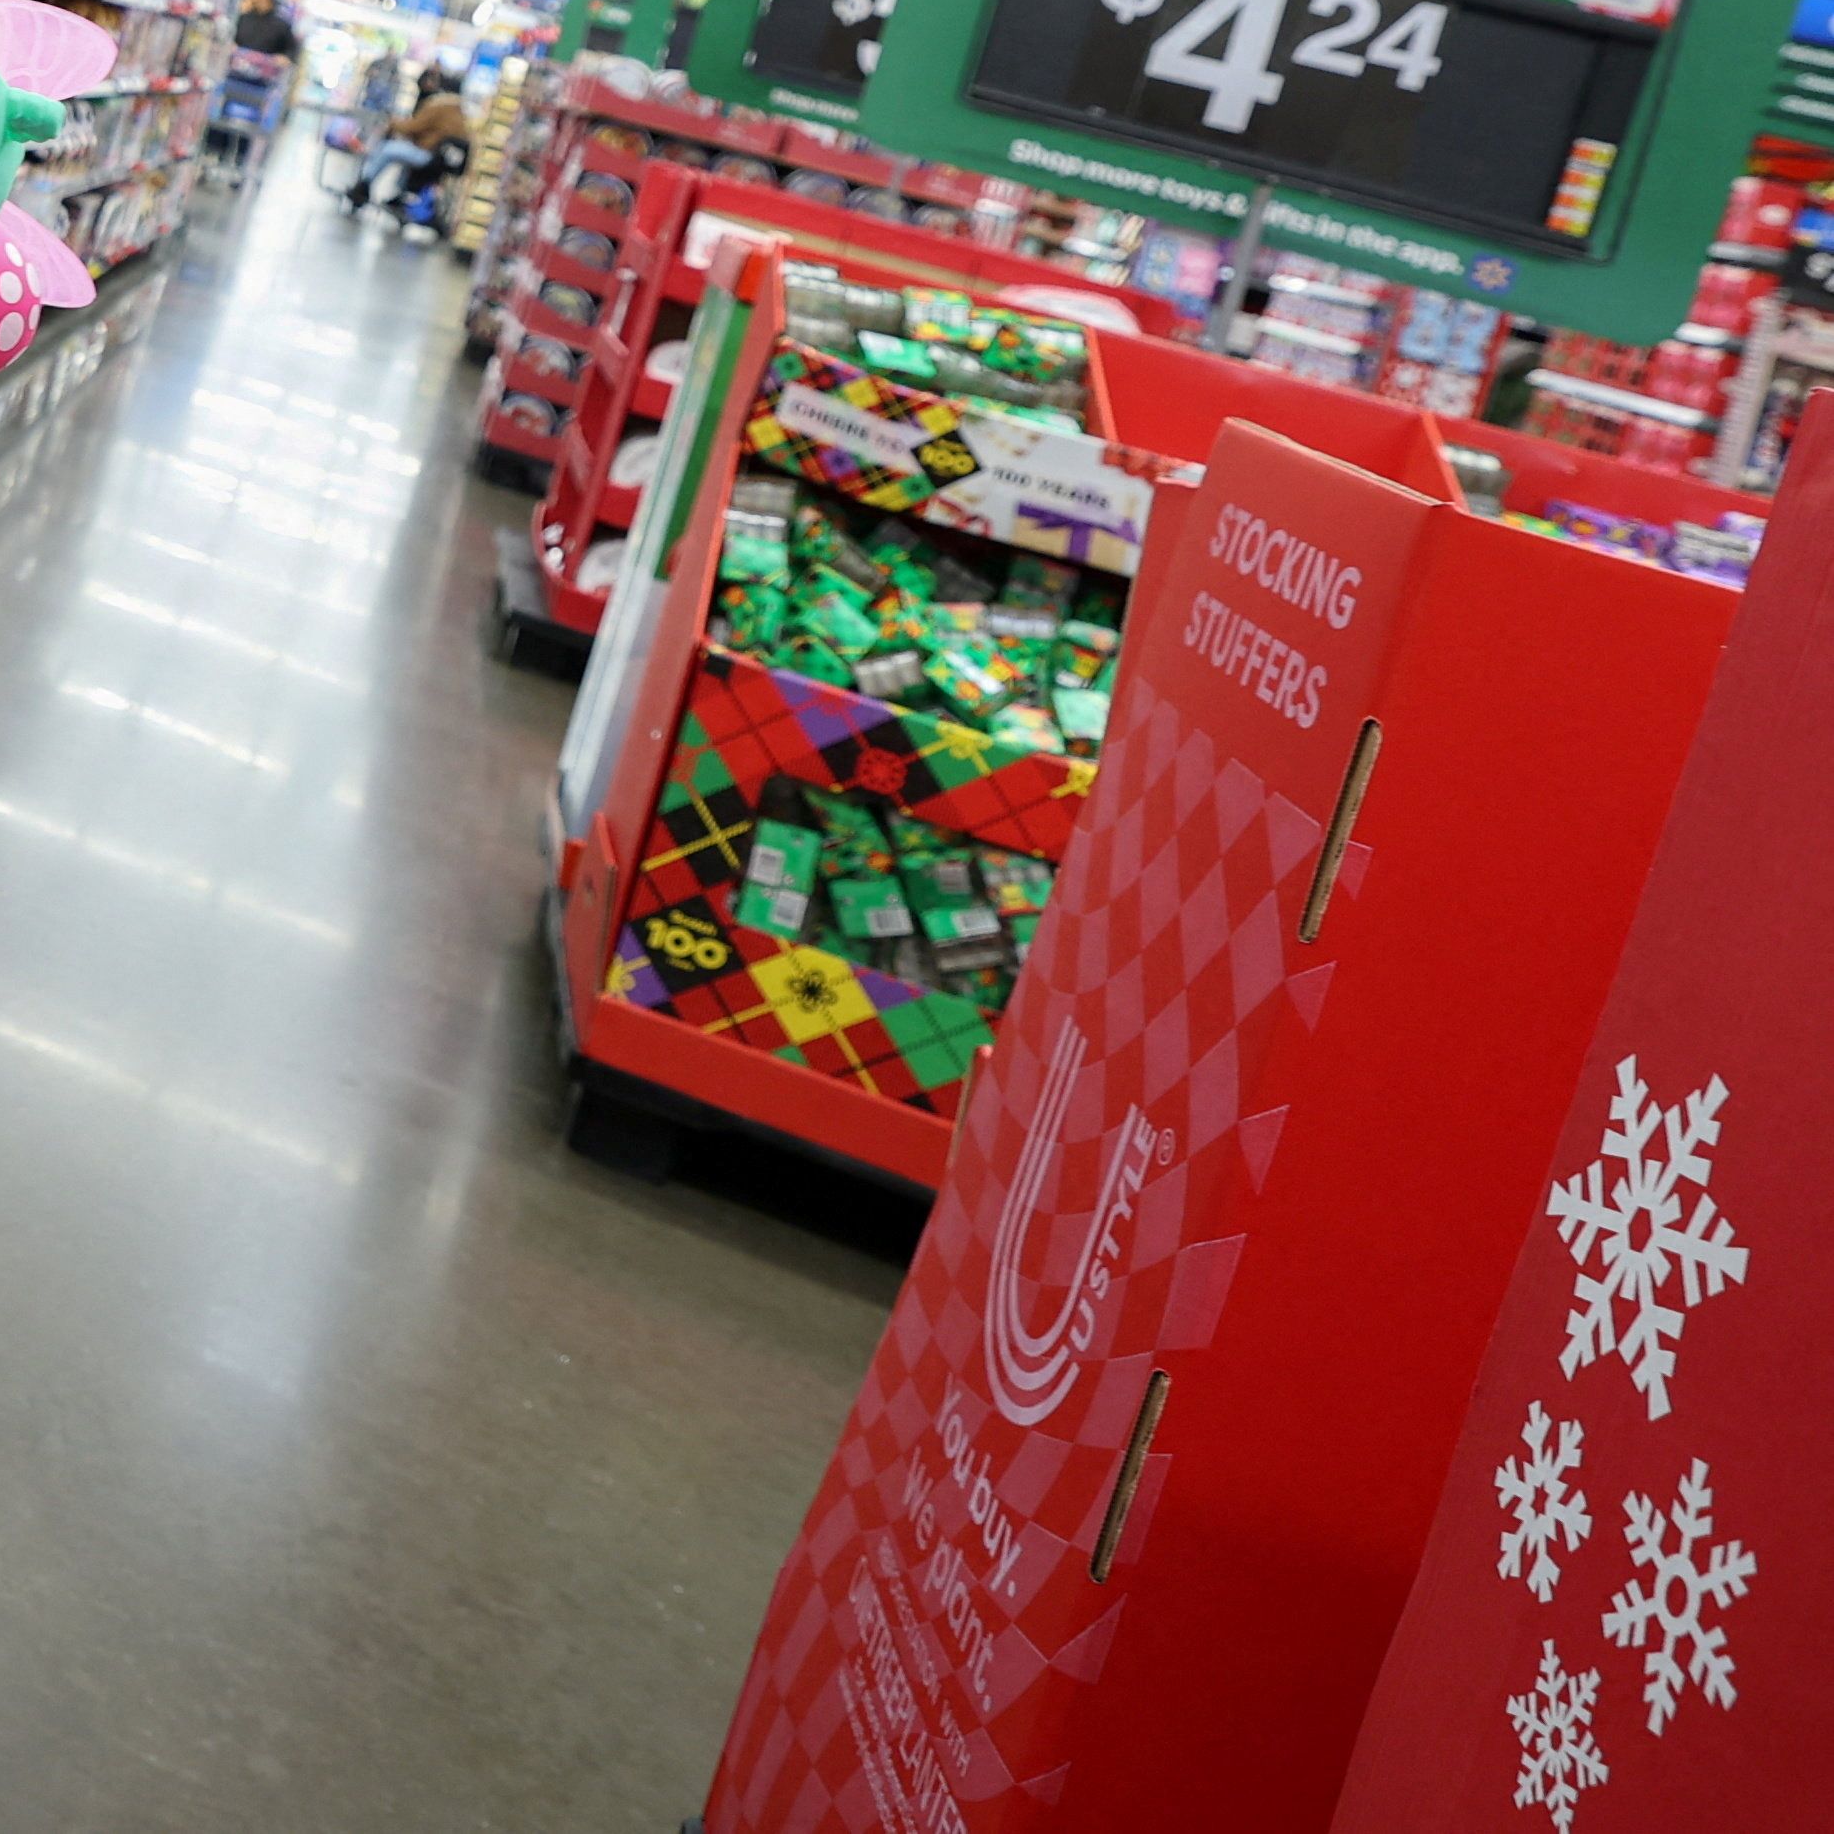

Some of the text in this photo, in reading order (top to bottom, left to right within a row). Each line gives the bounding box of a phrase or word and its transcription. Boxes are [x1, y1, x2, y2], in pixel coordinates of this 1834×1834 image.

[1007, 137, 1085, 178] Shop
[1082, 159, 1162, 197] more
[1158, 174, 1223, 218] toys
[1260, 199, 1318, 236] ifts
[1344, 222, 1399, 259] the
[1208, 502, 1363, 630] STOCKING
[1184, 590, 1328, 729] STUFFERS
[644, 917, 729, 970] 100
[937, 1372, 1023, 1599] You buy.
[901, 1446, 935, 1551] We
[922, 1535, 994, 1713] plant.
[848, 1554, 972, 1834] ONETREEPLANTE
